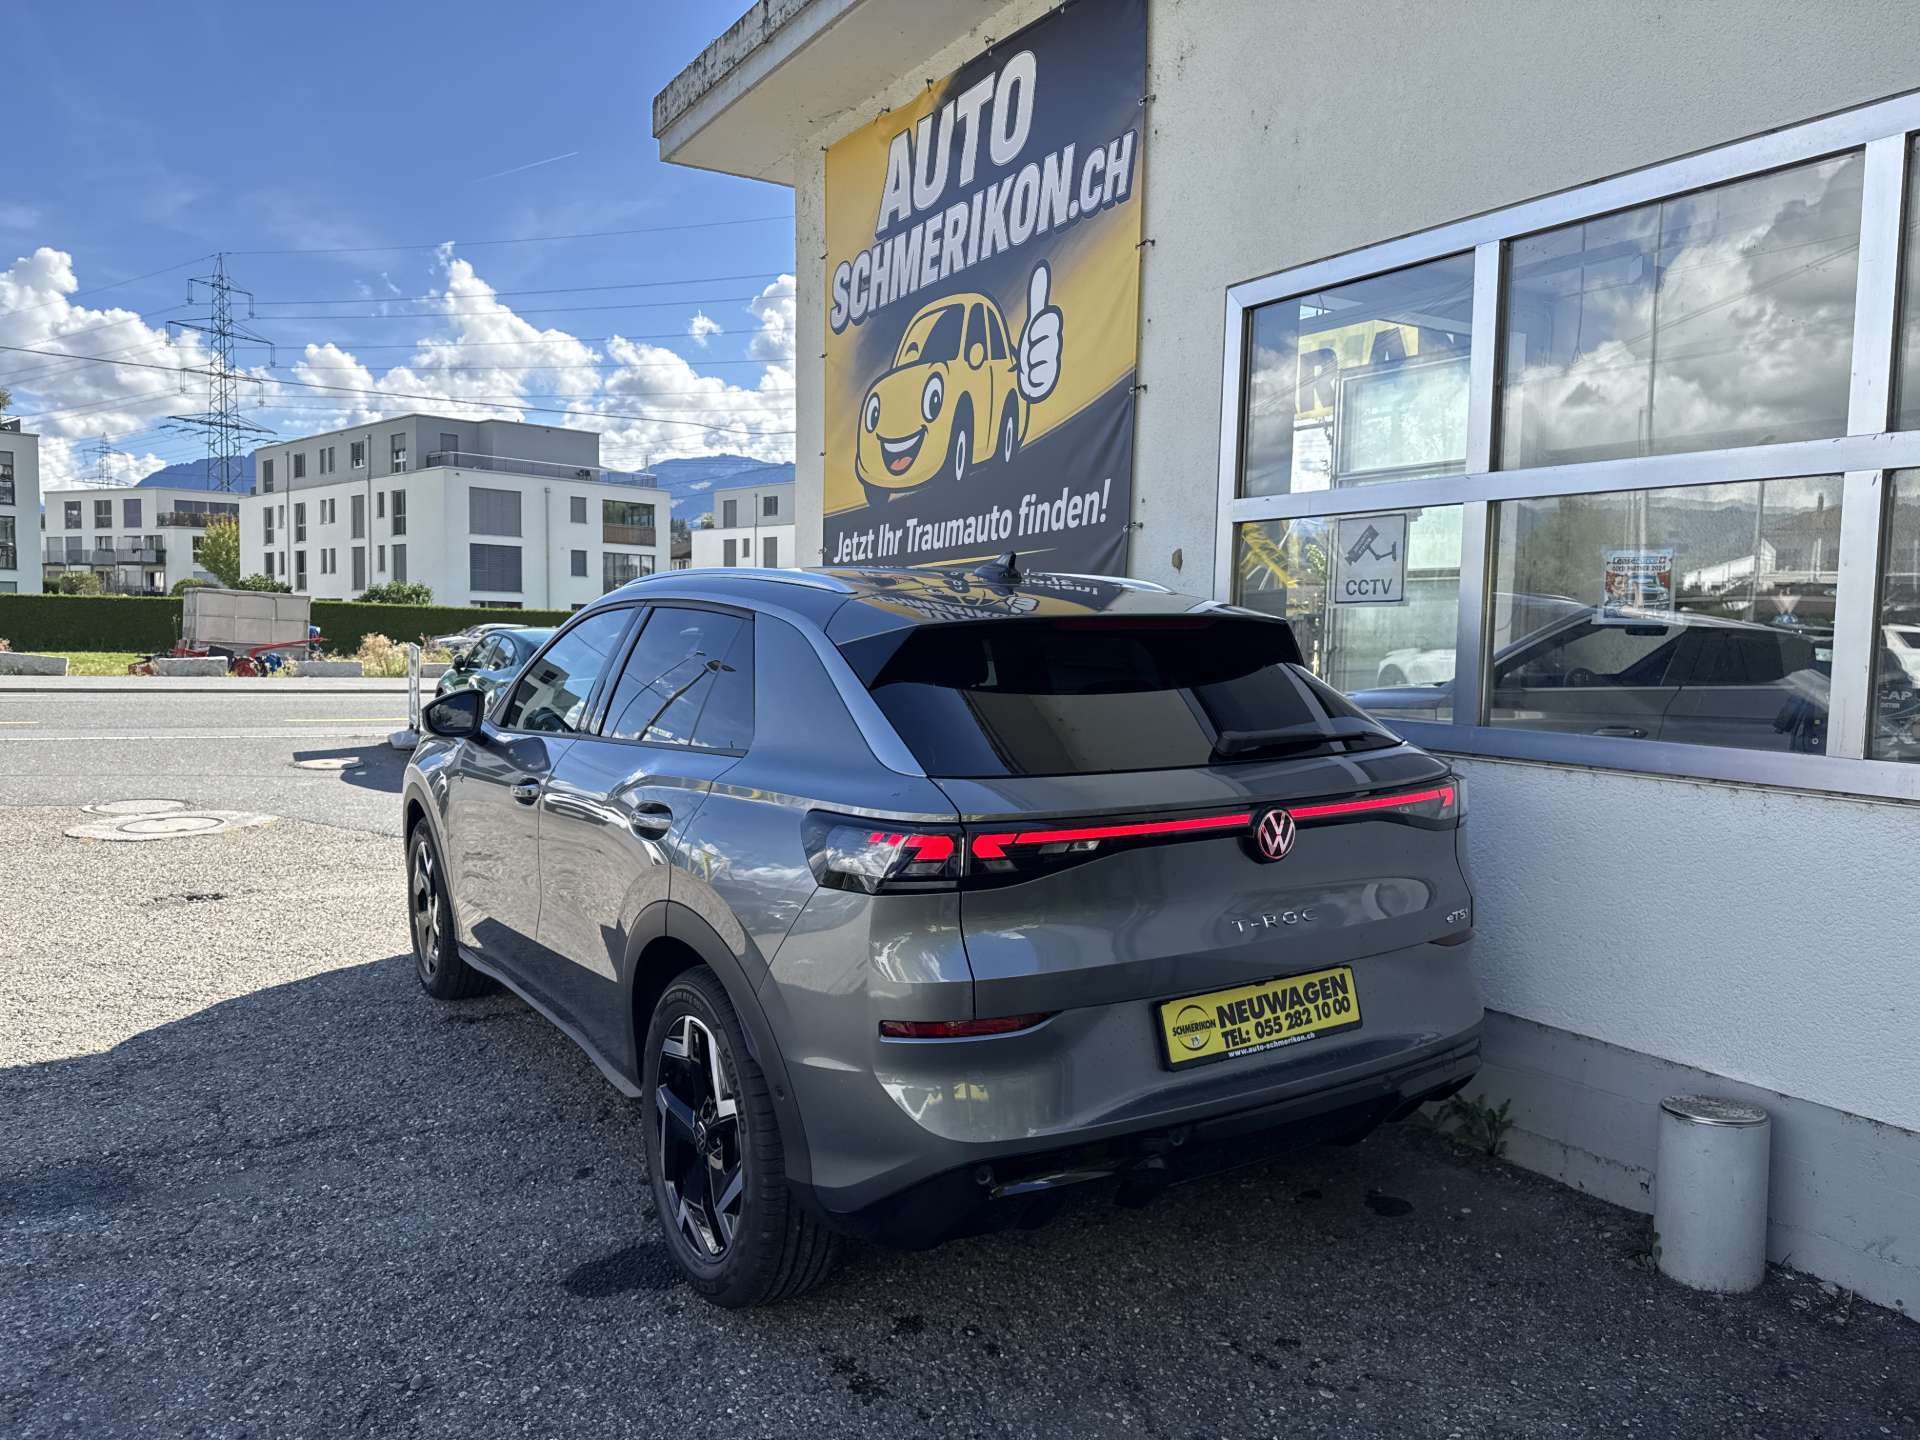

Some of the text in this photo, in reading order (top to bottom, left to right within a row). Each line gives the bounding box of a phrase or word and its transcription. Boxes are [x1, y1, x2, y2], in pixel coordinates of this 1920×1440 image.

[876, 50, 1037, 235] AUTO
[830, 130, 1138, 331] SCHMERIKON.CH
[833, 478, 1112, 564] Jetzt Ihr Traumauto finden!
[1345, 578, 1392, 596] CCTV
[1231, 907, 1319, 933] T-ROC
[1172, 1018, 1217, 1037] SCHMERIKON
[1216, 973, 1349, 1029] NEUWAGEN
[1221, 996, 1351, 1049] TEL: 055 282 10 00
[1227, 1032, 1316, 1058] www.auto-schmerikon.ch
